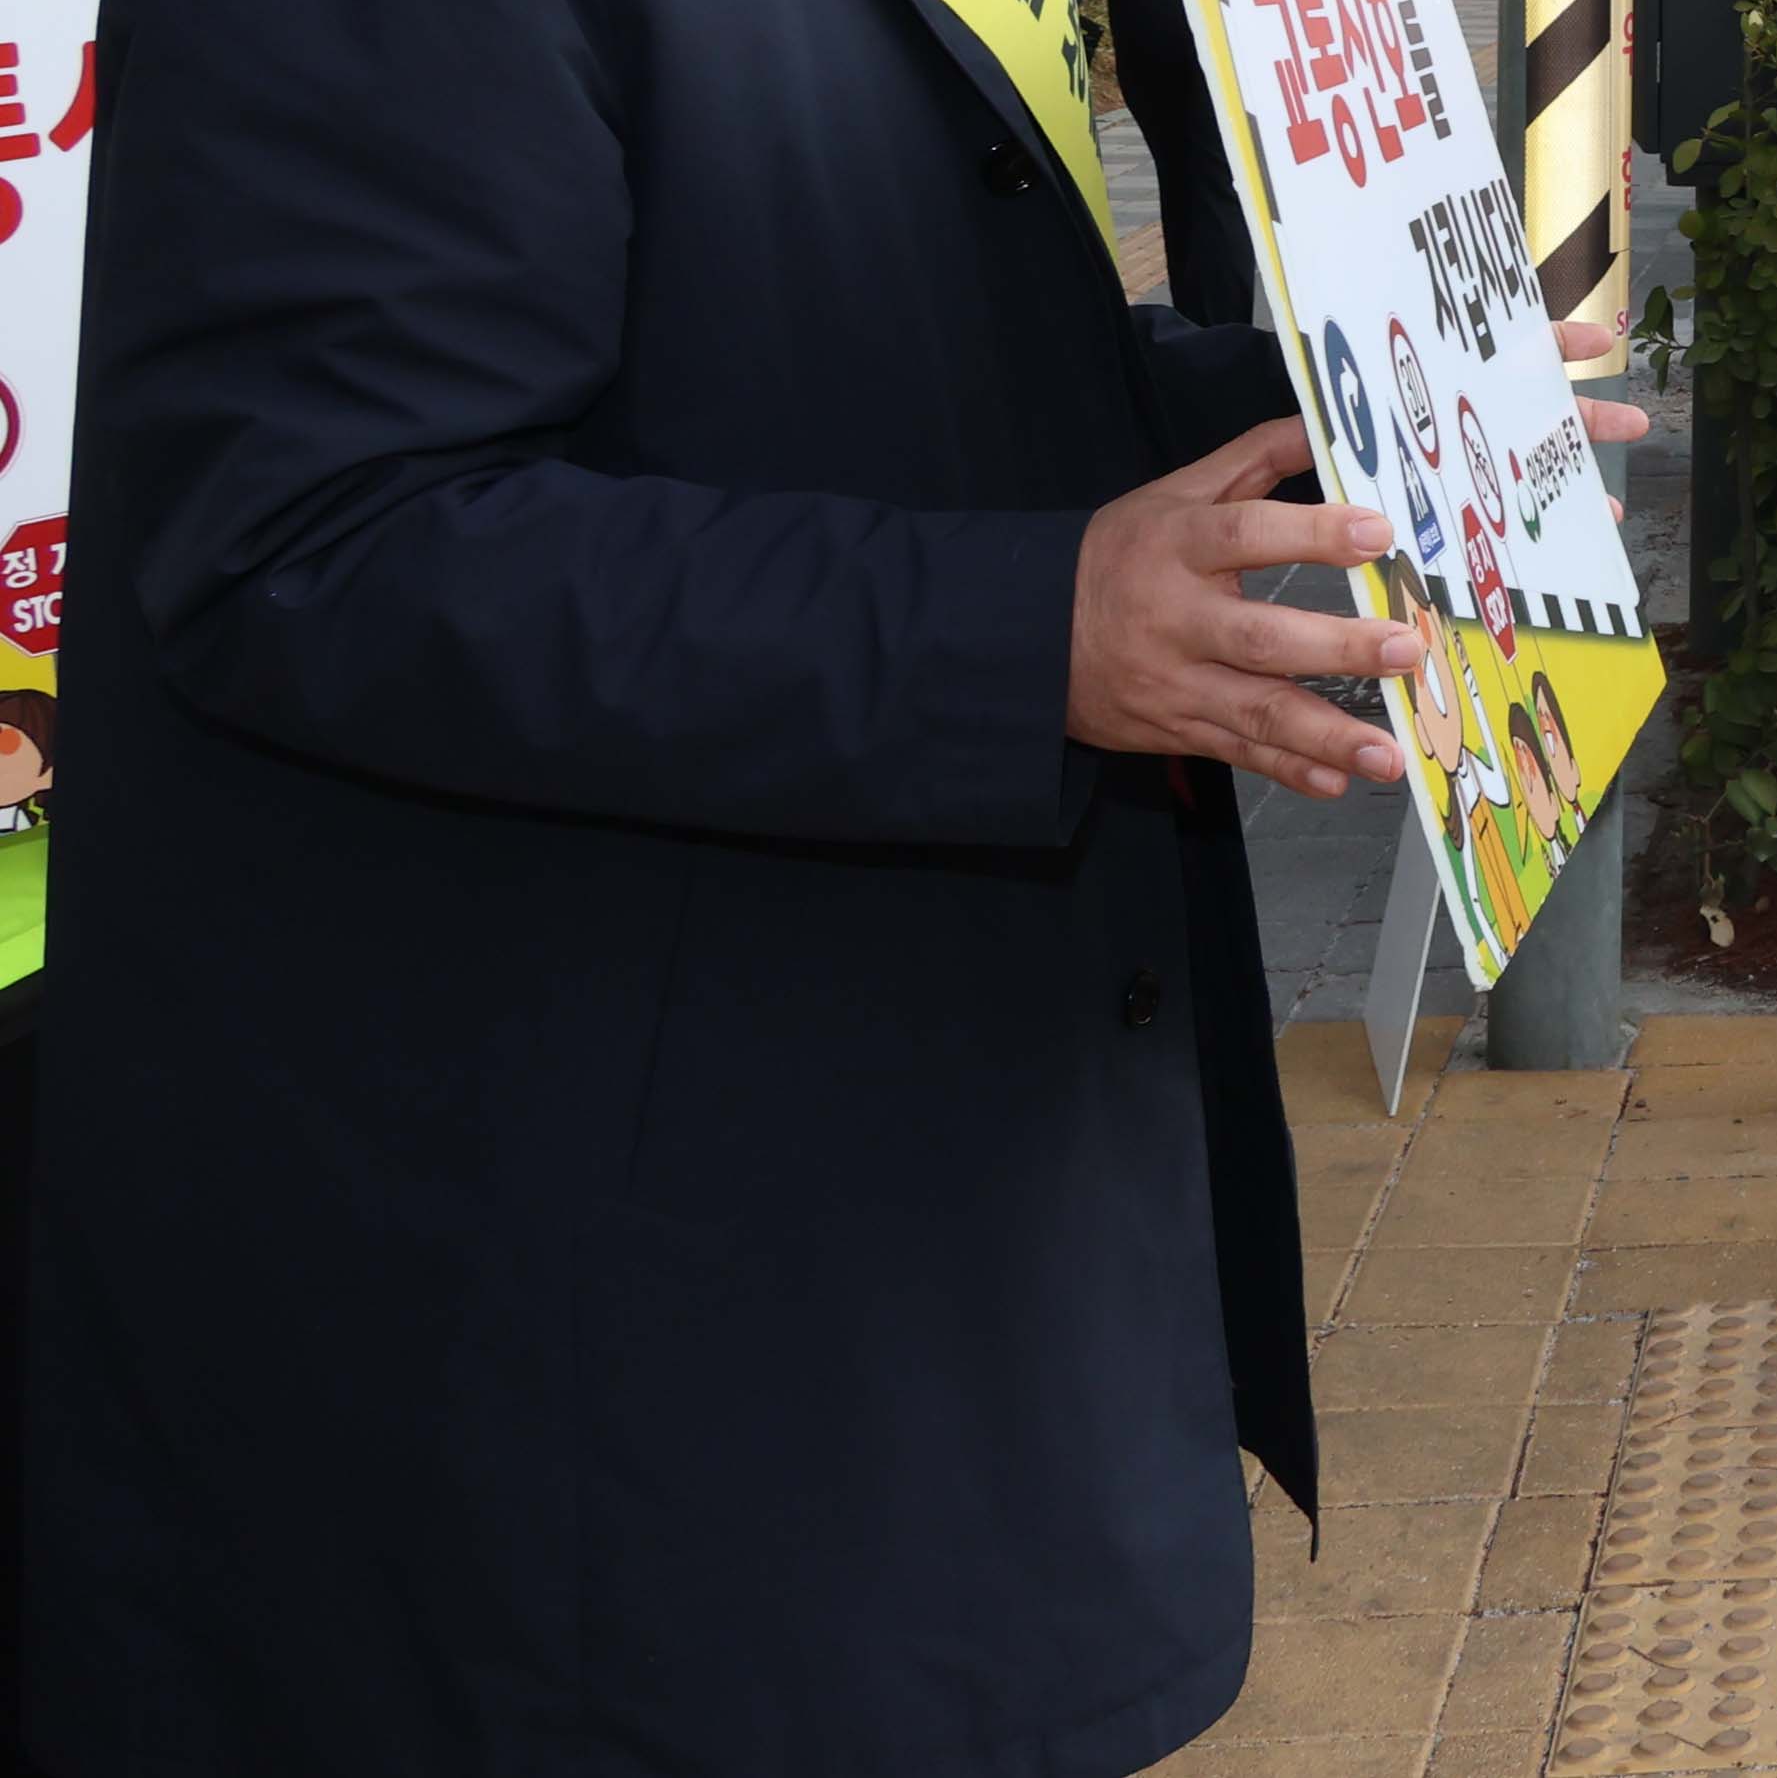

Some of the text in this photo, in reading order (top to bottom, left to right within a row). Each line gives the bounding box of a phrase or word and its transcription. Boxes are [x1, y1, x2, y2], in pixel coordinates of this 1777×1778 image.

[1409, 178, 1541, 363] 지킵시다!
[1400, 354, 1427, 419] 30
[1526, 428, 1574, 511] 인천광역시
[1467, 529, 1495, 583] 정지
[1485, 586, 1509, 635] STOP
